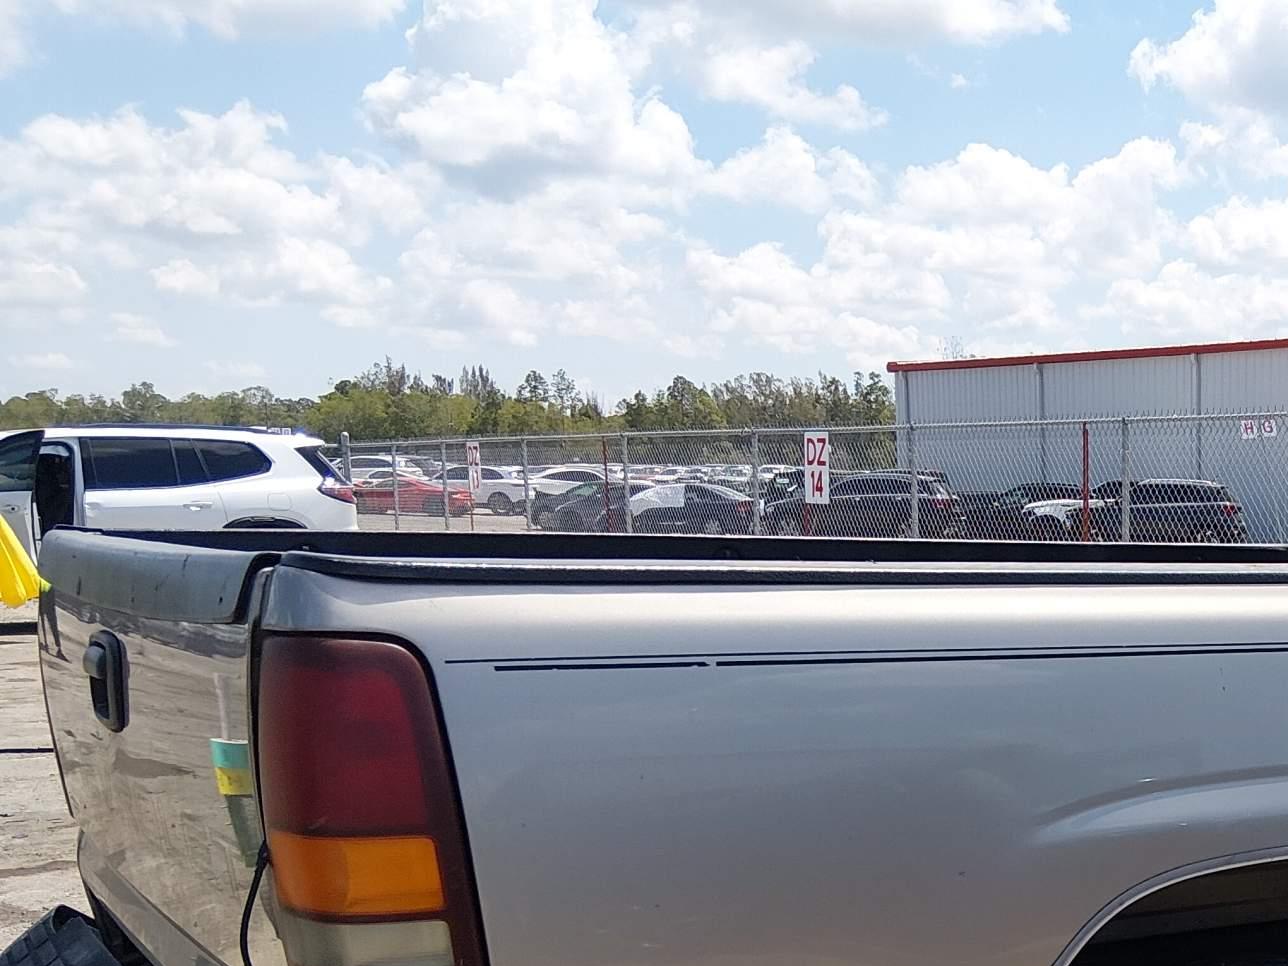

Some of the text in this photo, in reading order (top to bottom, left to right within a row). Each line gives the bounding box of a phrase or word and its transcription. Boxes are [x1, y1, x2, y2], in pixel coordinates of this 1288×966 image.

[1243, 420, 1273, 435] H G
[468, 445, 479, 466] DZ
[806, 437, 827, 467] DZ
[810, 470, 824, 498] 14
